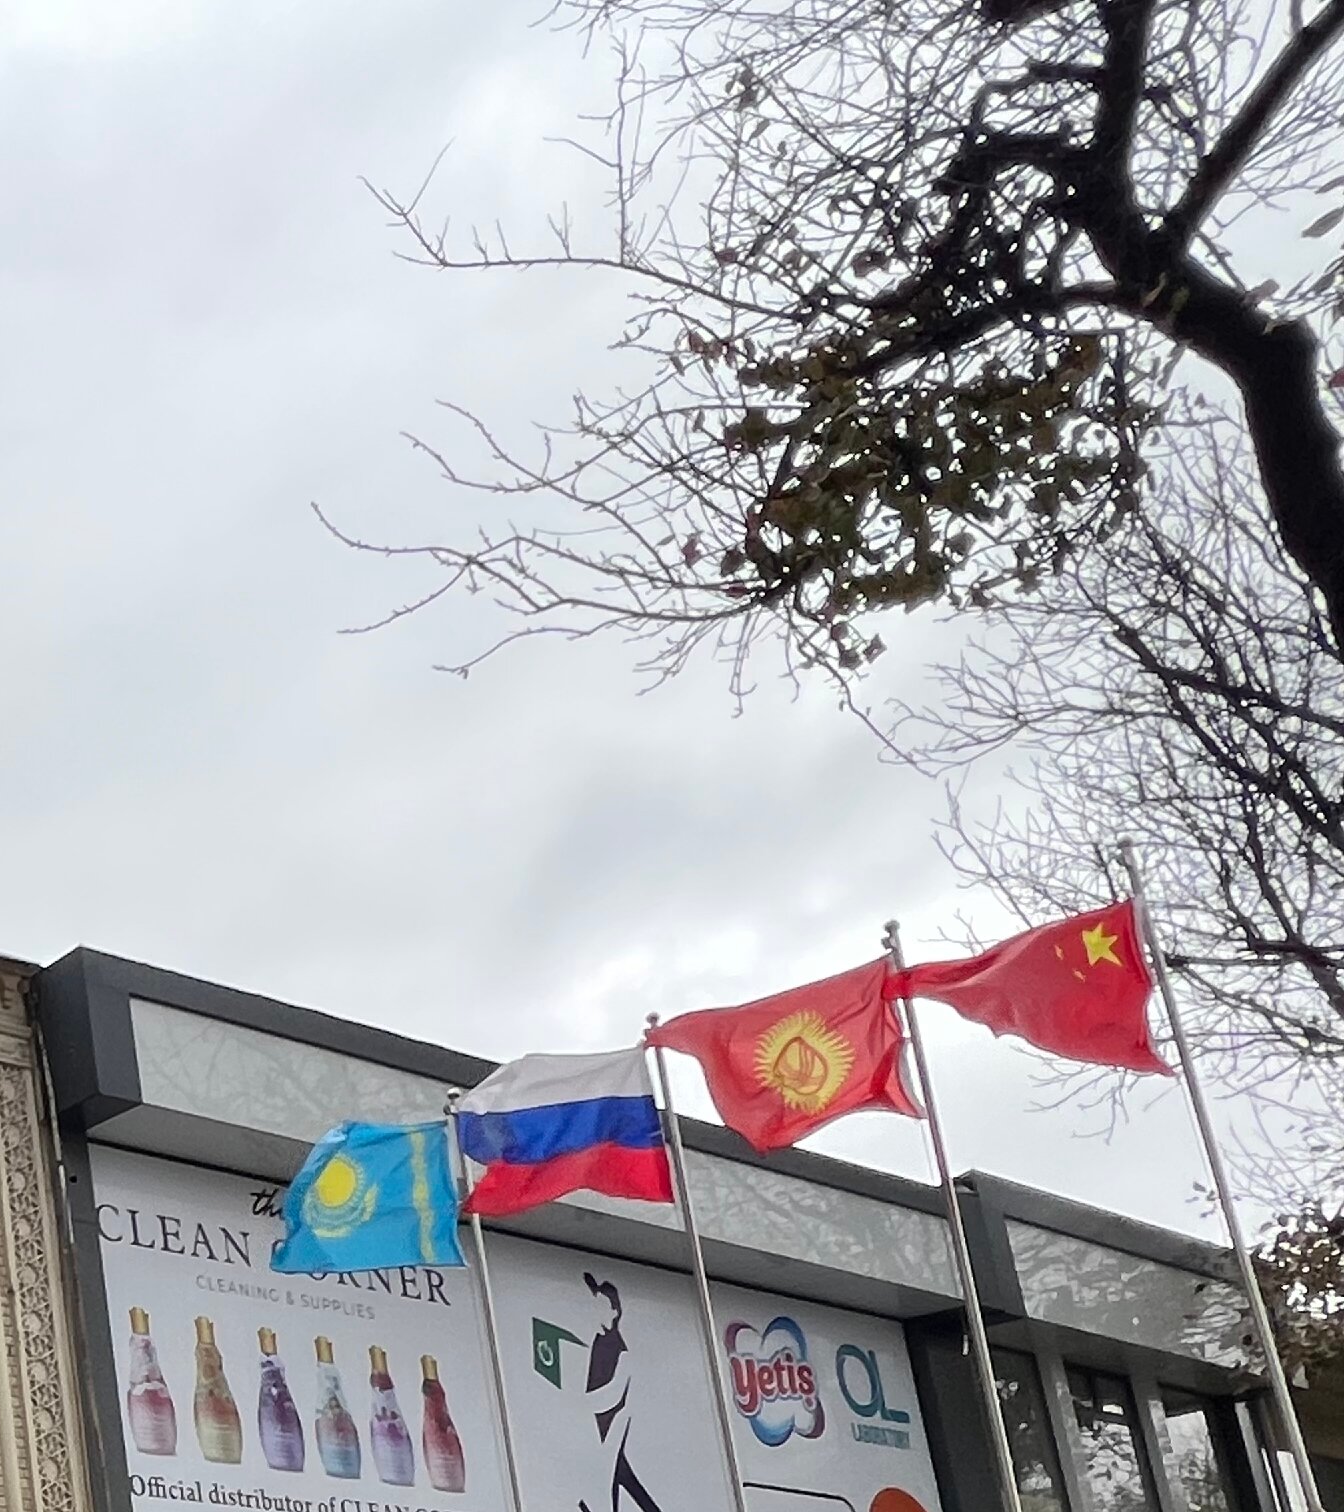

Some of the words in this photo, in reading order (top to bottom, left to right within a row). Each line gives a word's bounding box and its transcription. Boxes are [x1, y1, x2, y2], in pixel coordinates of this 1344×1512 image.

[97, 1203, 252, 1268] CLEAN
[195, 1273, 280, 1305] CLEANING
[285, 1290, 295, 1306] &
[300, 1296, 377, 1321] SUPPLIES
[130, 1474, 204, 1504] Official
